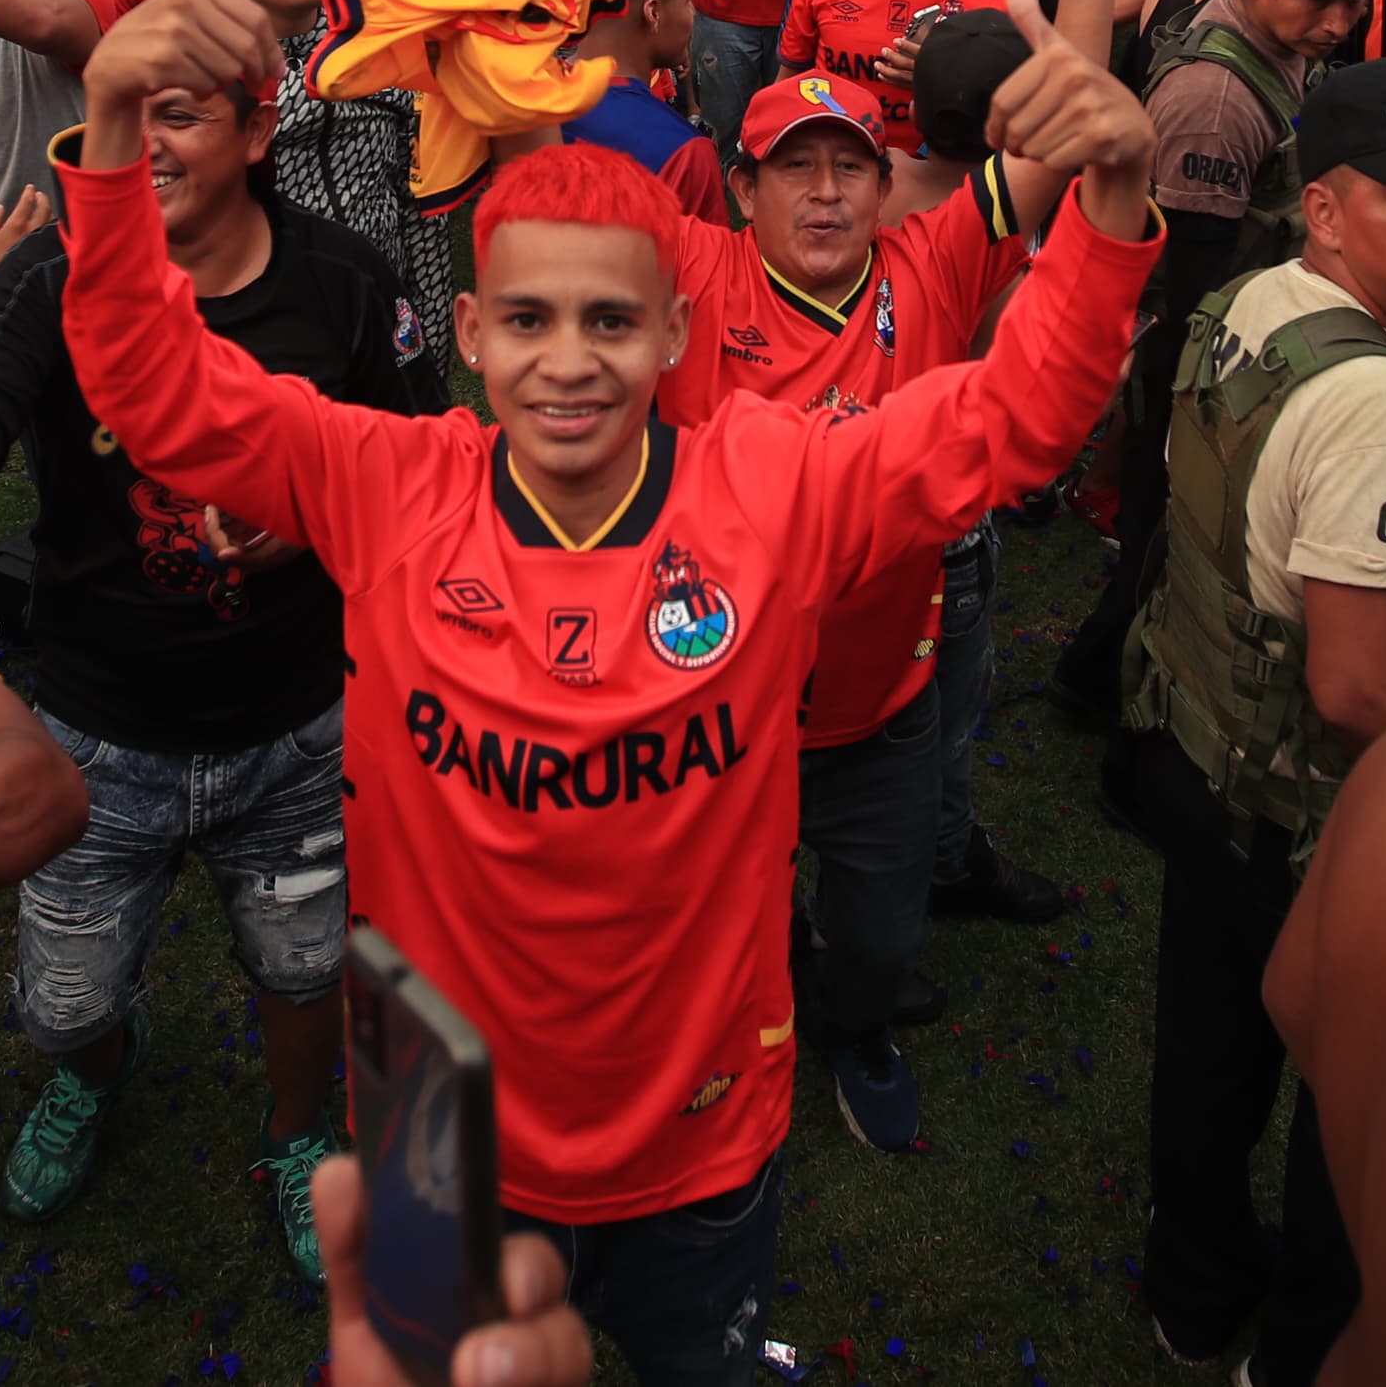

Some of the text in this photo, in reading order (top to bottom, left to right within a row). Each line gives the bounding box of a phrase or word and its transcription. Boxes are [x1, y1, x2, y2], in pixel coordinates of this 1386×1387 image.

[891, 2, 907, 23] Z
[721, 343, 773, 366] umbro
[434, 608, 494, 640] umbro
[553, 615, 590, 665] Z
[405, 688, 749, 814] BANRURAL
